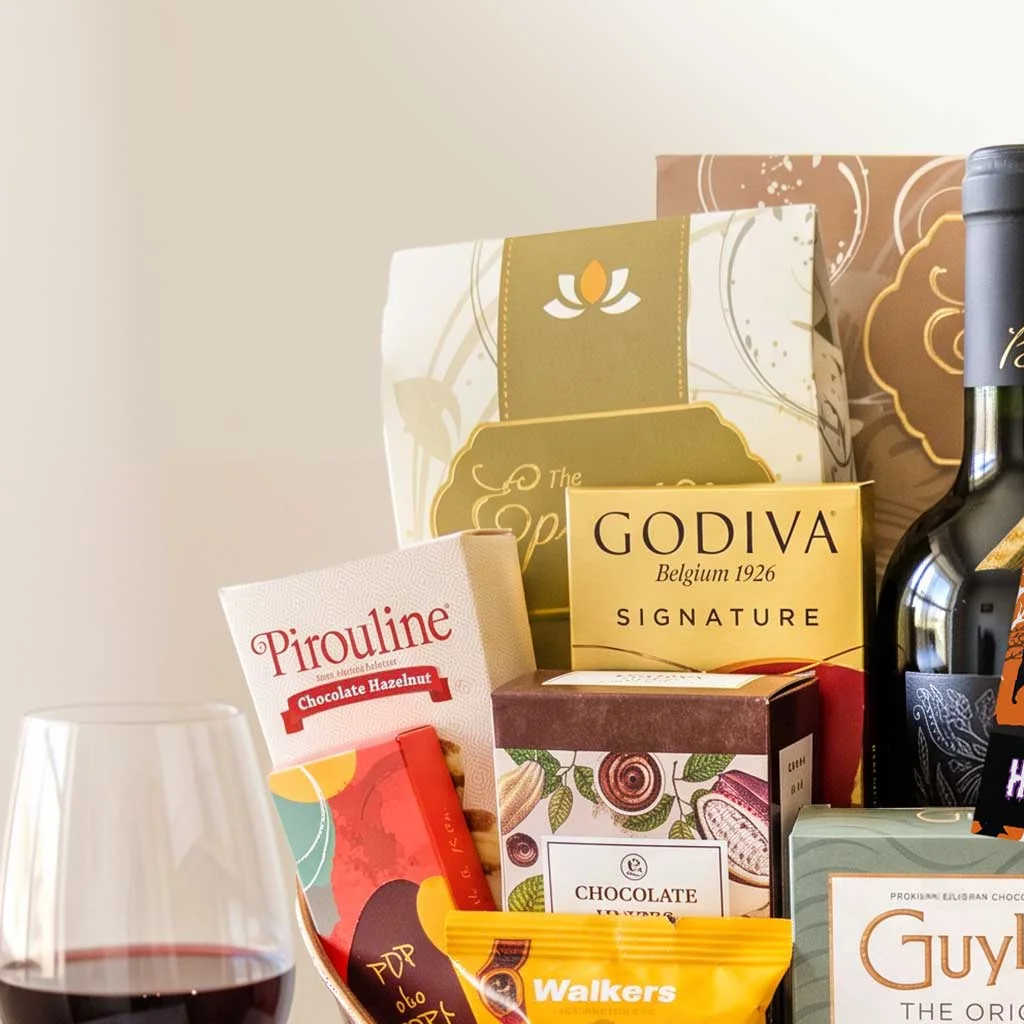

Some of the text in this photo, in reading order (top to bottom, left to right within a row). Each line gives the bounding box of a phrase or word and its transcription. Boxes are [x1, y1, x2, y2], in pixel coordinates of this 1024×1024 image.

[550, 466, 582, 488] The
[594, 510, 838, 555] GODIVA
[656, 564, 776, 587] Belgium 1926
[617, 608, 819, 626] SIGNATURE
[250, 605, 452, 677] Pirouline
[297, 671, 432, 710] Chocolate Hazelnut
[574, 885, 698, 904] CHOCOLATE
[532, 978, 677, 1003] Walkers
[900, 1002, 953, 1021] THE
